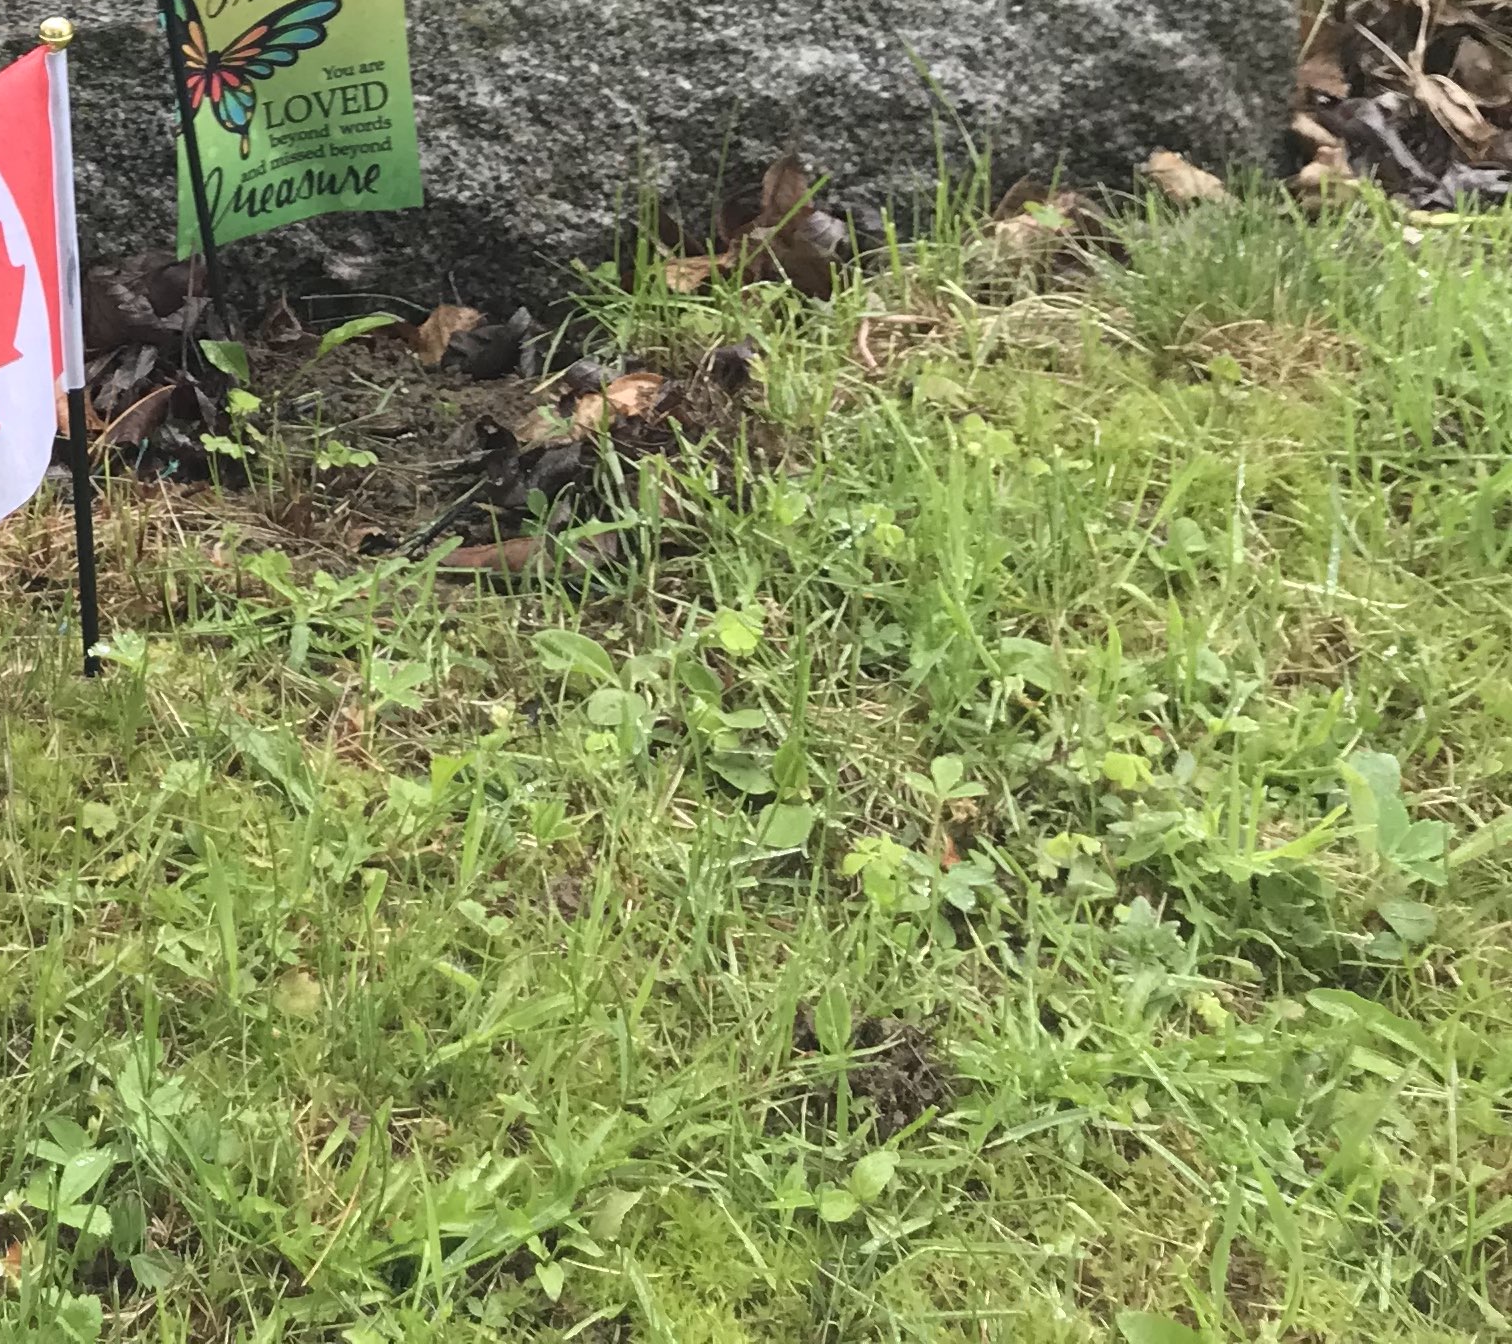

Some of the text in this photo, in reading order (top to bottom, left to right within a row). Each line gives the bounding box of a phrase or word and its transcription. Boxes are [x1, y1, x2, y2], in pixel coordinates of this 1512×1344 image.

[322, 60, 386, 81] You are
[261, 80, 389, 131] LOVED
[269, 115, 394, 149] beyond words
[240, 135, 394, 184] and missed beyond
[196, 163, 382, 233] Measure
